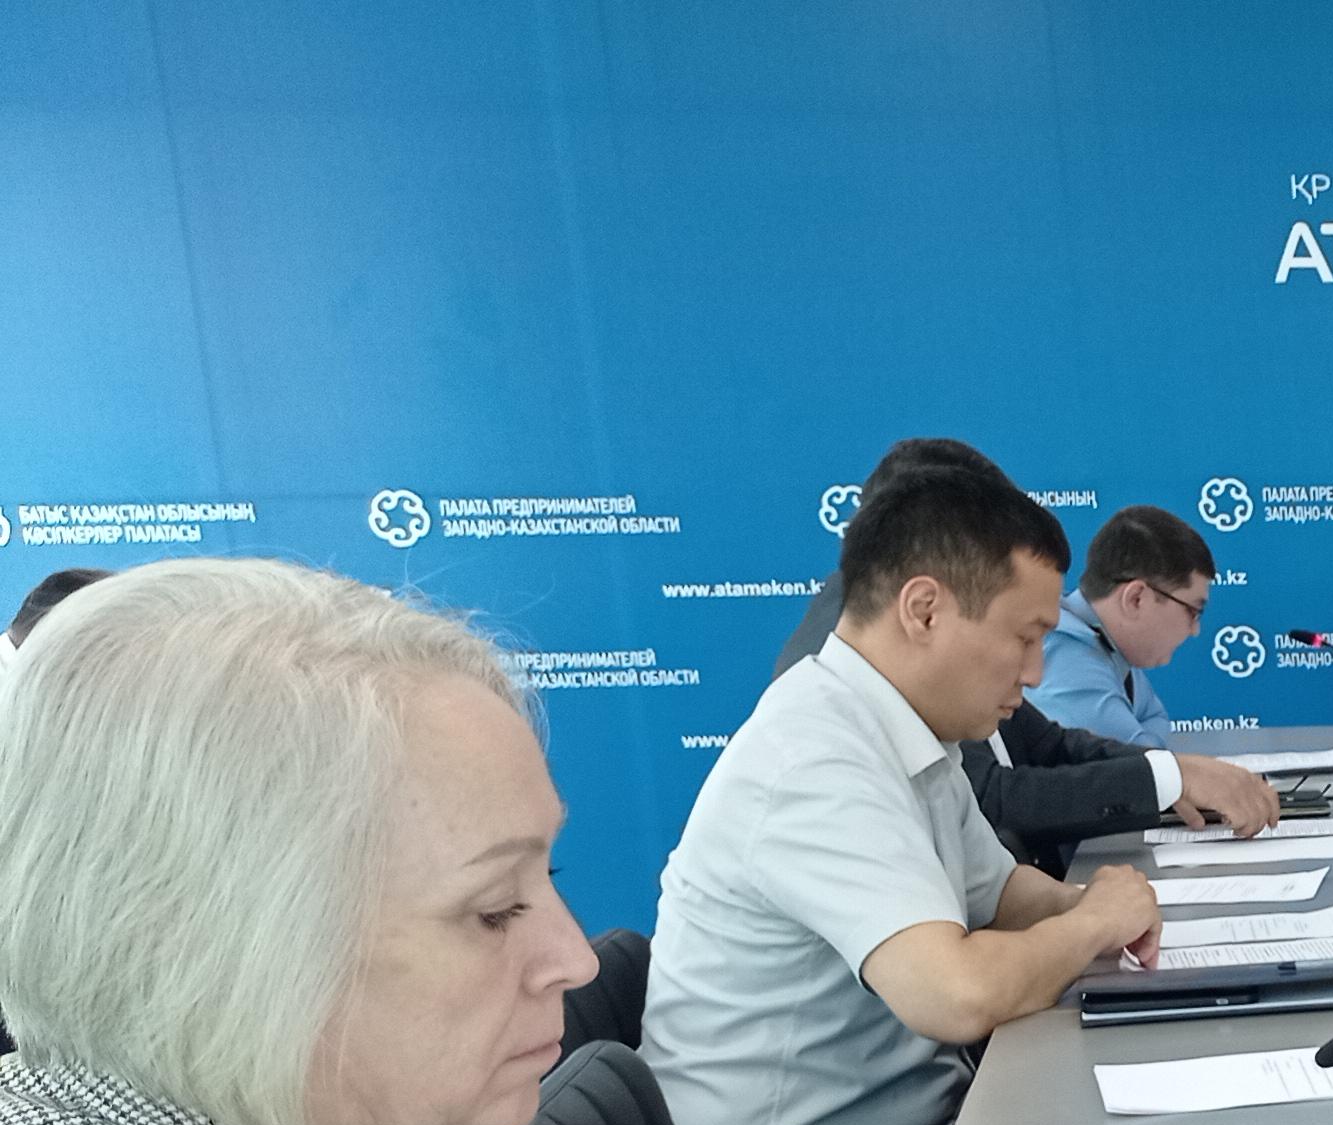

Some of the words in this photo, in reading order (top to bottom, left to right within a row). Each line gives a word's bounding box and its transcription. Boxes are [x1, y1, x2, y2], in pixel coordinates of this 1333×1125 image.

[1290, 174, 1331, 205] ҚР
[1262, 487, 1309, 503] ПАЛАТА
[18, 504, 69, 524] БАТЫС
[440, 499, 492, 517] ПАЛАТА
[493, 495, 636, 518] ПРЕДПРИНИМАТЕЛЕЙ
[125, 525, 201, 543] ПАЛАТАСЫ
[443, 517, 619, 540] ЗАПАДНО-КАЗАХСТАНСКОЙ
[620, 517, 681, 534] ОБЛАСТИ
[662, 579, 827, 598] www.atameken.k
[515, 648, 656, 671] ПРЕДПРИНИМАТЕЛЕЙ
[640, 669, 700, 686] ОБЛАСТИ
